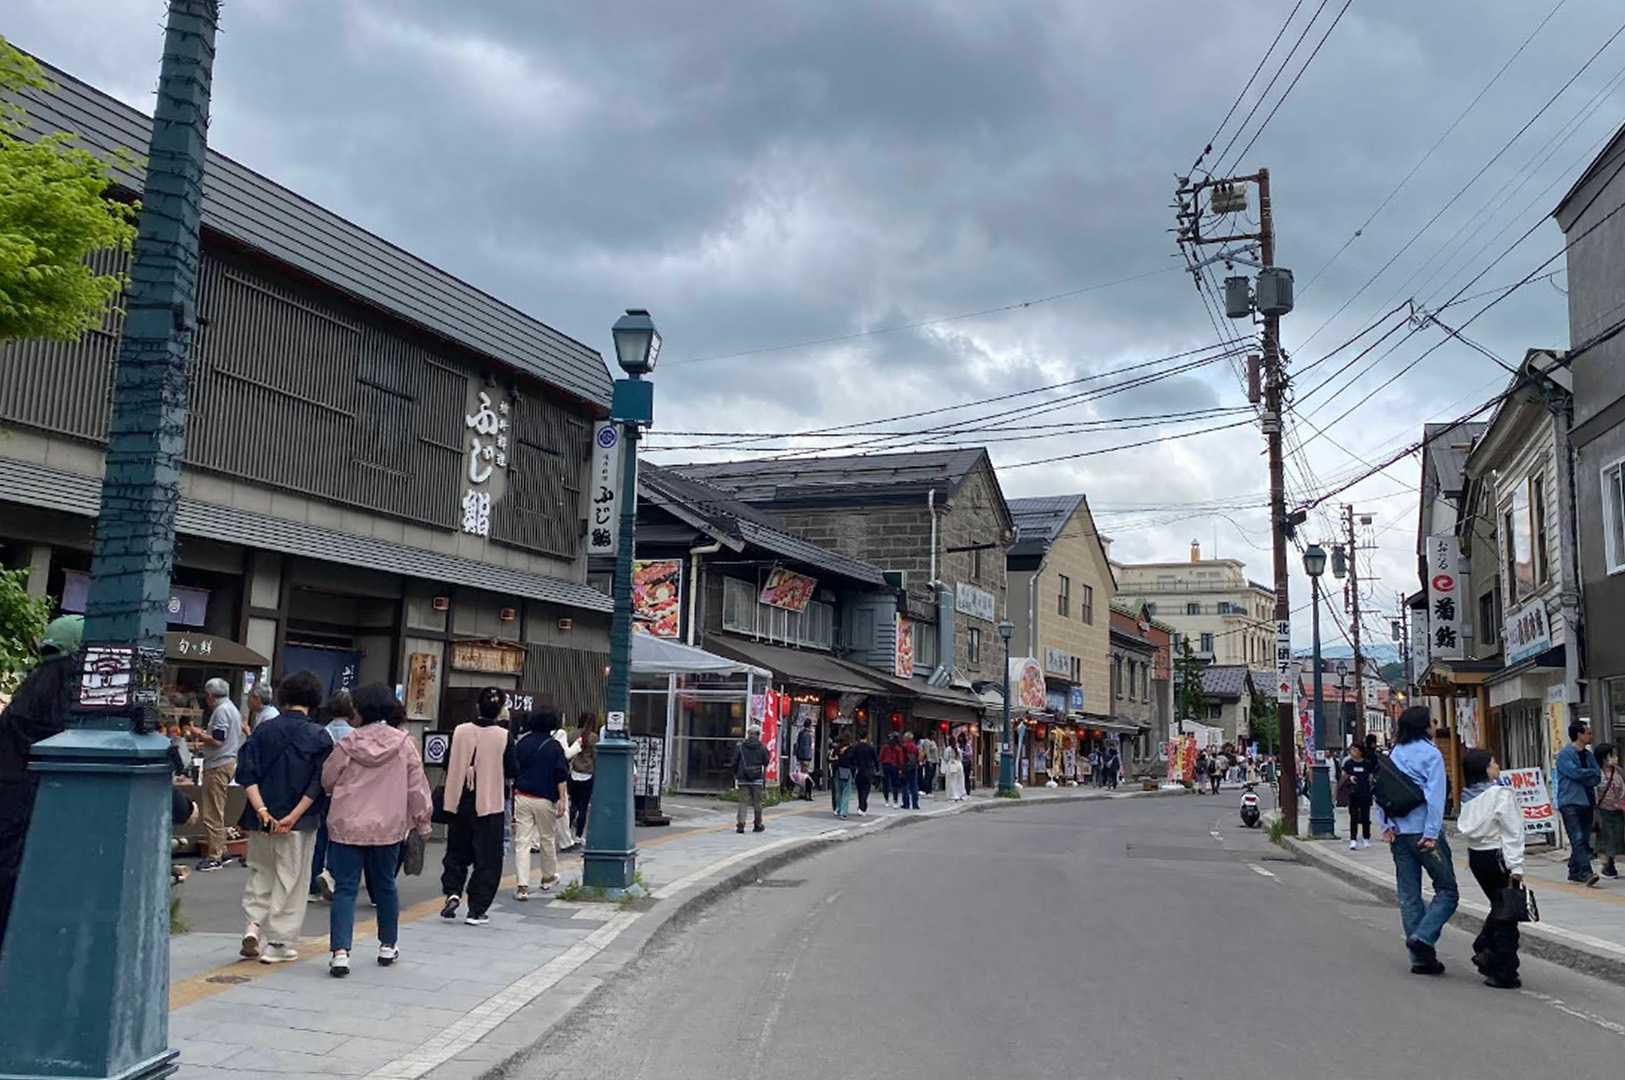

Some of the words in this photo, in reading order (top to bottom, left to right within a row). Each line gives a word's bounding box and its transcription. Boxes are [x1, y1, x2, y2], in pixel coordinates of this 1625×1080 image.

[464, 392, 497, 536] ふじ鮨
[591, 486, 614, 547] ふじ鮨
[1437, 541, 1449, 570] おたる
[1277, 622, 1290, 674] 北一硝子
[1434, 597, 1457, 649] 菊鮨
